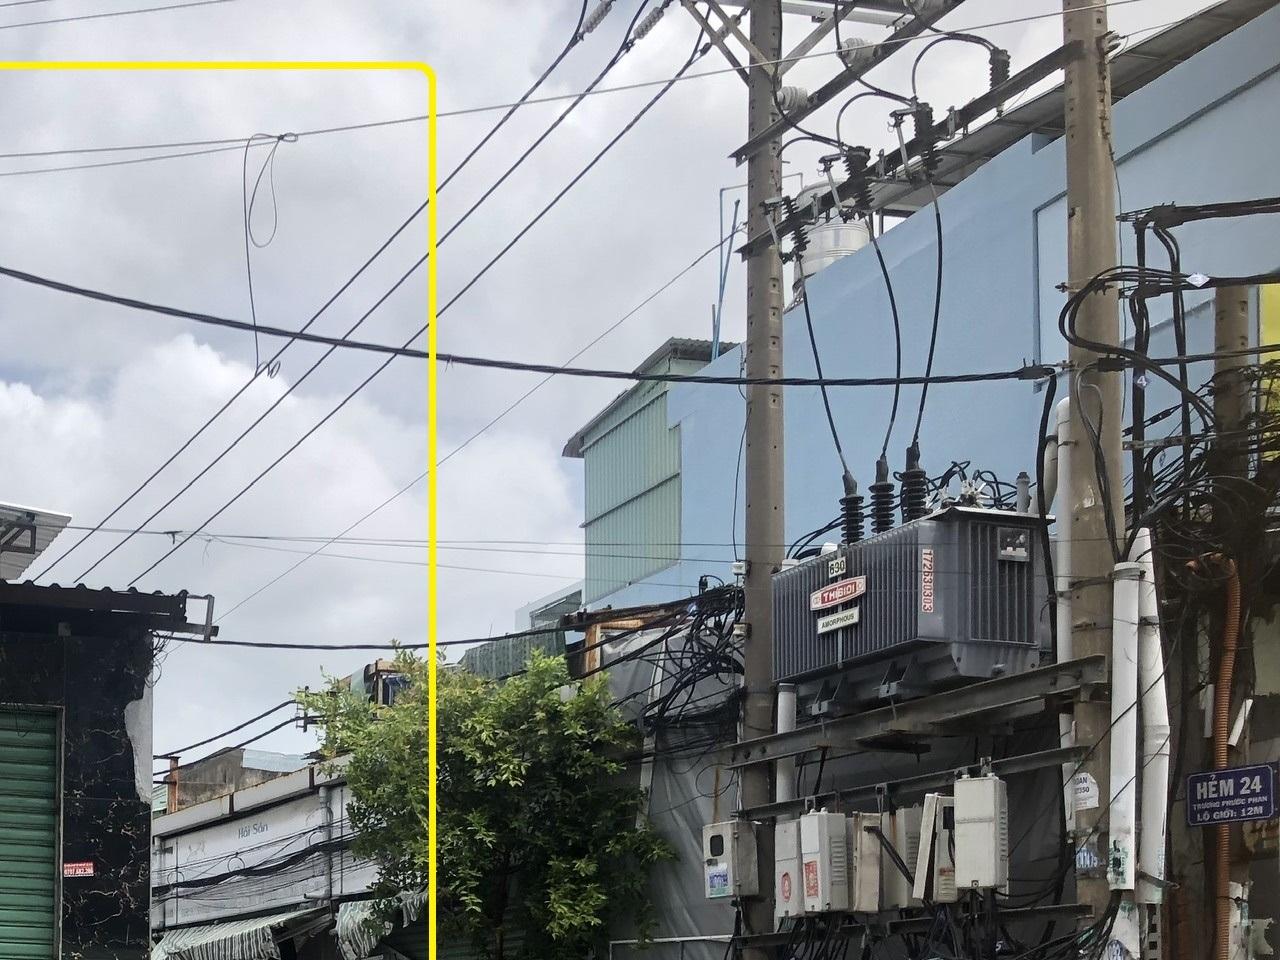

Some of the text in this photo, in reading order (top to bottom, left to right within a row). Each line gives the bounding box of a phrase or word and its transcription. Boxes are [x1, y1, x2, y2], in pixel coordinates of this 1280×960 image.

[829, 559, 846, 576] 630
[823, 582, 856, 603] THIBIDI
[821, 612, 855, 629] AMORPHOUS
[1196, 774, 1262, 800] HẺM 24
[1248, 795, 1268, 804] PHAN
[1241, 805, 1263, 817] 12M
